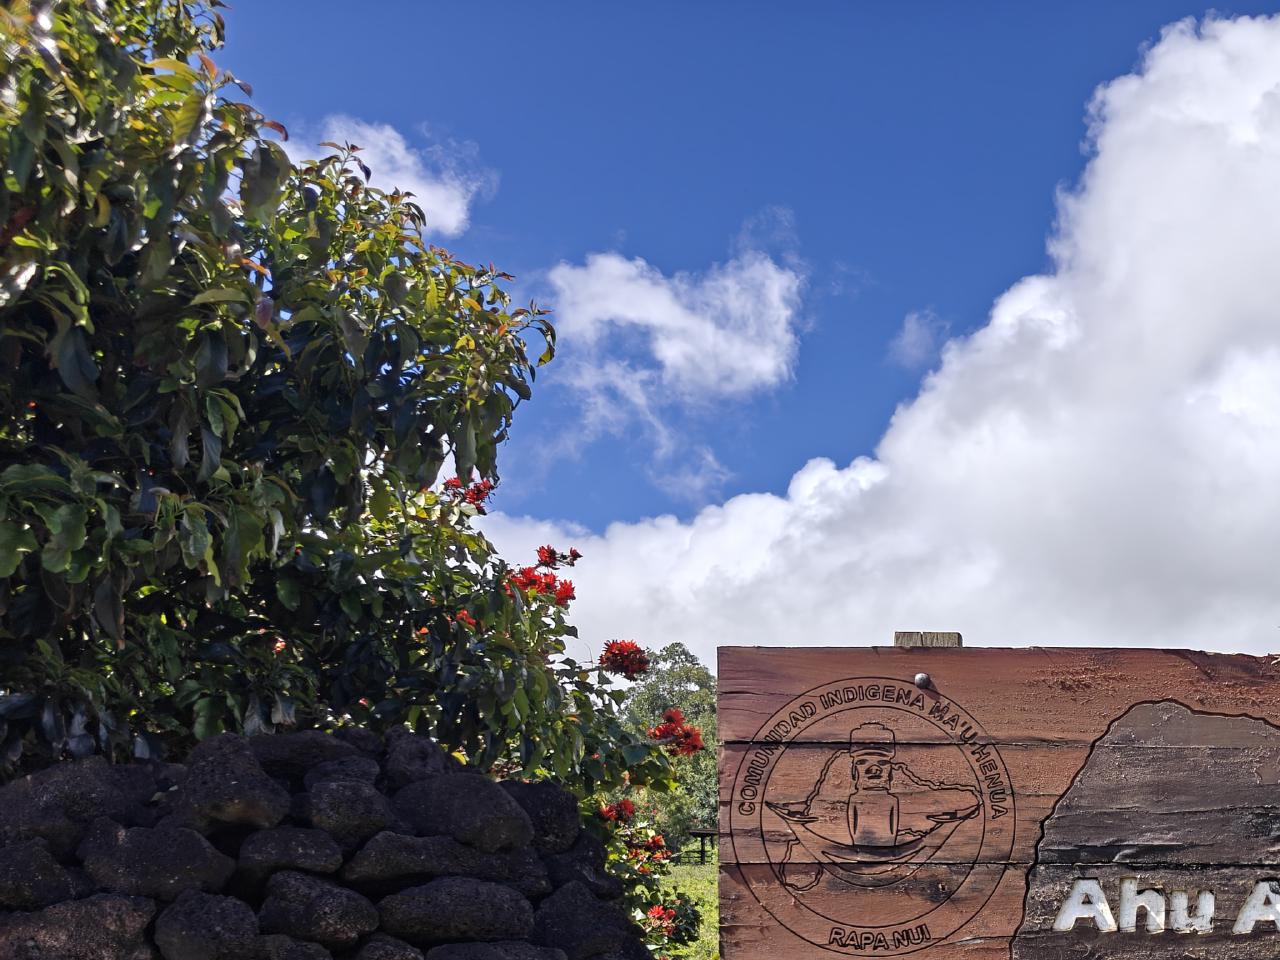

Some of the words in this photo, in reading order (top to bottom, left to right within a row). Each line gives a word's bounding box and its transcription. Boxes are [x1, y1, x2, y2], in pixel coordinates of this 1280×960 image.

[738, 701, 817, 816] COMUNIDAD
[819, 684, 925, 711] INDIGENA
[928, 701, 978, 744] MA'U
[970, 743, 1009, 820] HENUA
[1053, 876, 1216, 934] Ahu
[828, 926, 889, 951] RAPA
[893, 923, 932, 948] NUI
